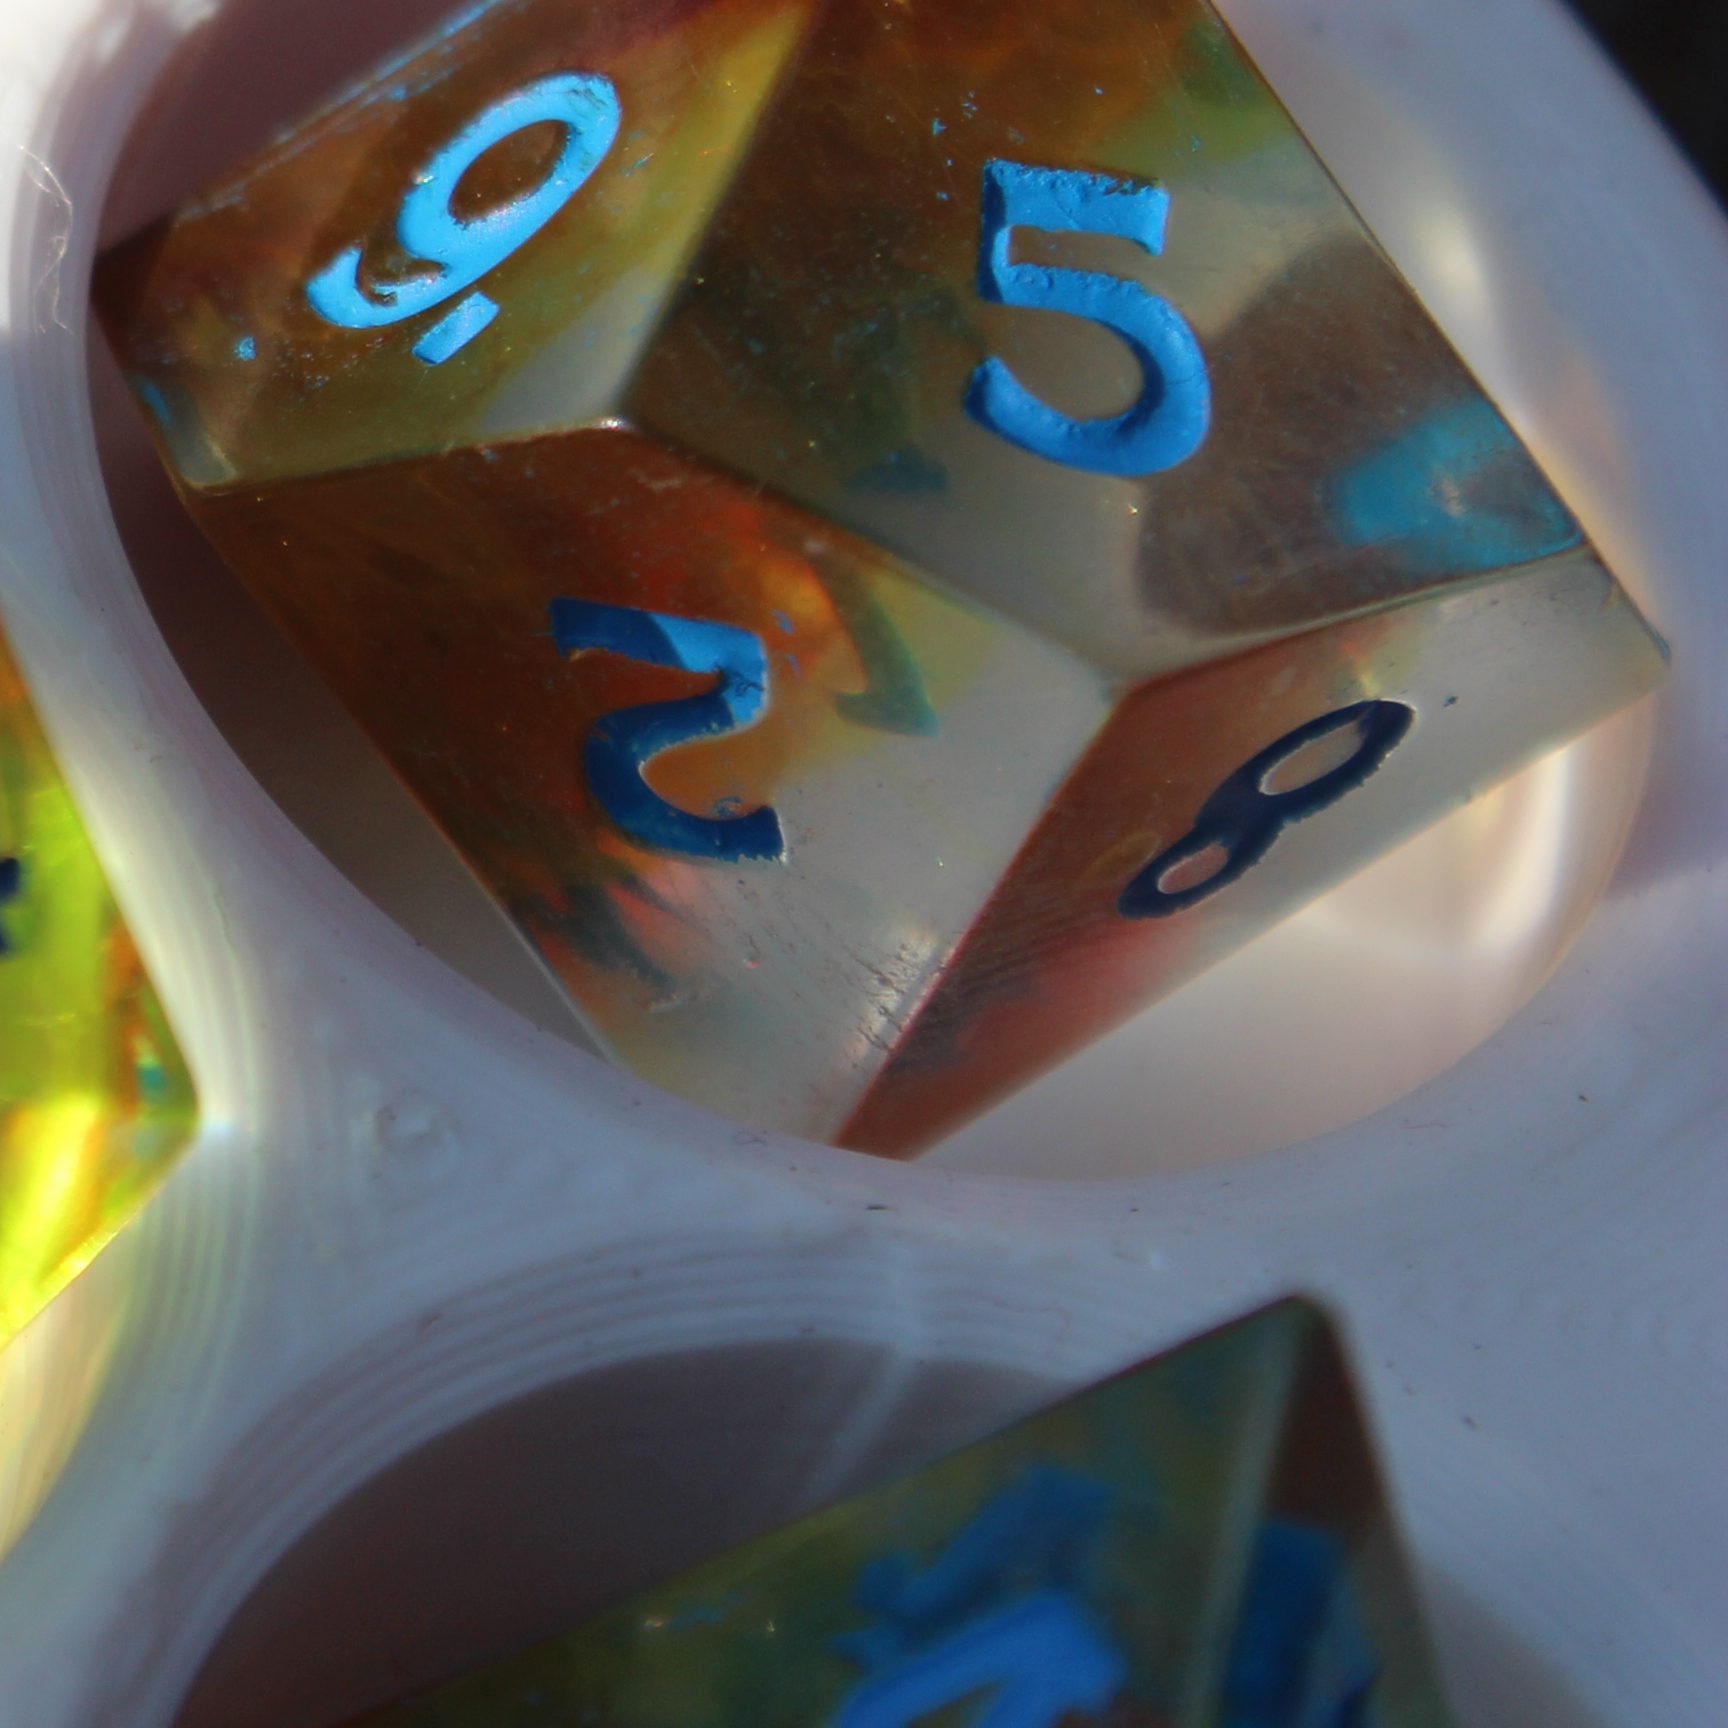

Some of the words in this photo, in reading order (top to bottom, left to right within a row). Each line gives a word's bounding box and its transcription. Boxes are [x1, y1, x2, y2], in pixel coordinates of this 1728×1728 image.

[961, 157, 1212, 477] 5
[550, 595, 787, 863] 2
[1117, 697, 1415, 921] 8
